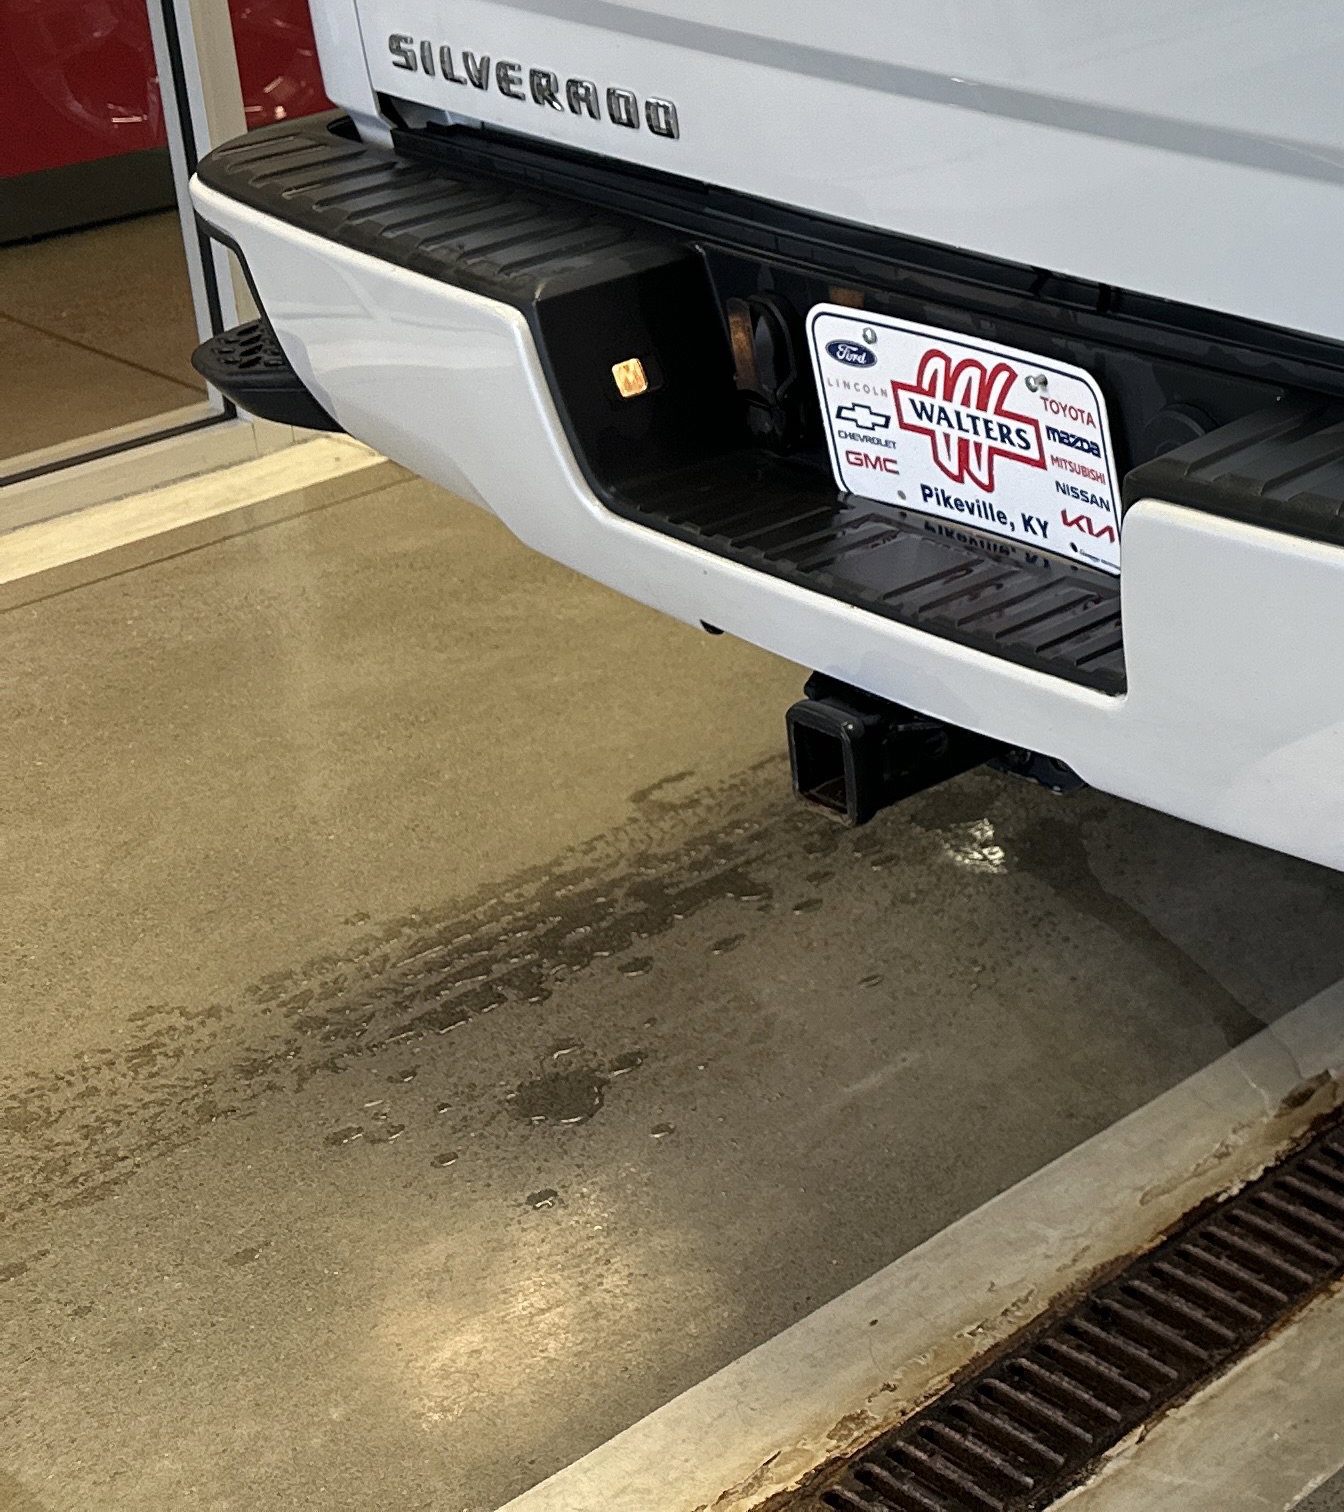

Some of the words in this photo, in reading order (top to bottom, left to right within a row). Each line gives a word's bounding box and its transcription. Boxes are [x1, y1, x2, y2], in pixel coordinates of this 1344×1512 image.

[388, 33, 681, 140] SILVERADO
[834, 342, 868, 366] Ford
[827, 376, 888, 398] LINCOLN
[908, 397, 1032, 451] WALTERS
[1040, 395, 1097, 429] TOYOTA
[837, 429, 897, 450] CHEVROLET
[845, 450, 900, 475] GMC
[1050, 454, 1107, 486] MITSUBISHI
[920, 483, 1016, 532] Pikeville,
[1020, 512, 1049, 539] KY
[1055, 480, 1111, 513] NISSAN
